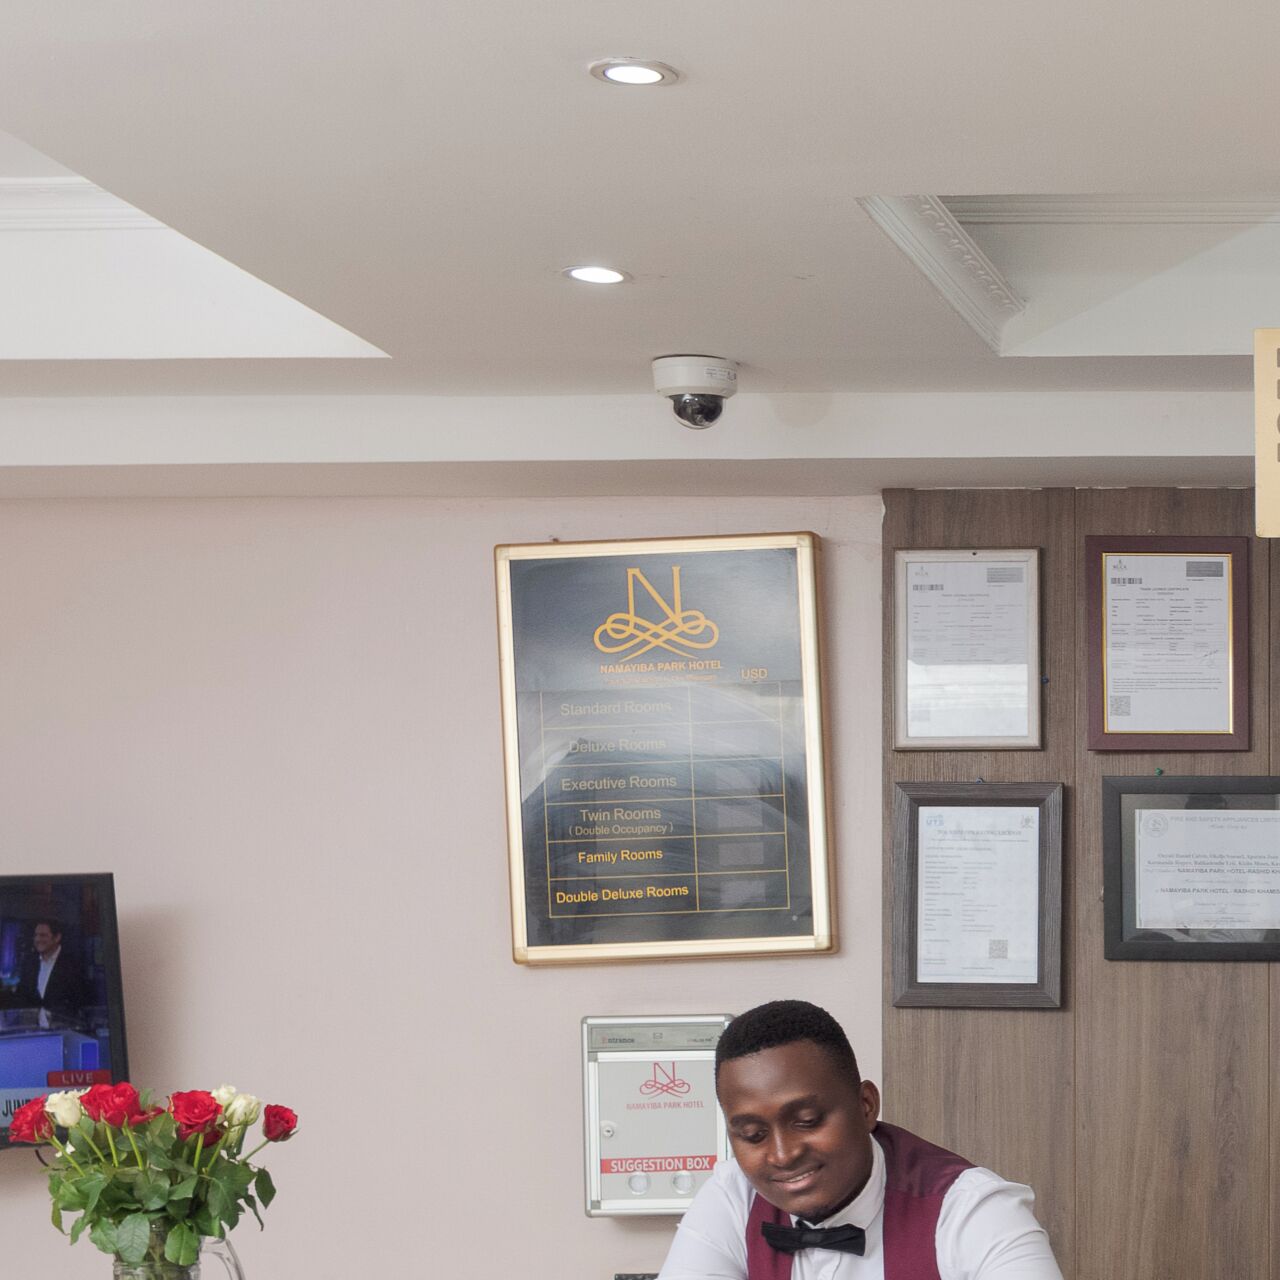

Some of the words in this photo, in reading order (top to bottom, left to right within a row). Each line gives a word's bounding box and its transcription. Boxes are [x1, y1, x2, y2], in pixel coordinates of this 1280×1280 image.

[600, 663, 655, 674] NAMAYIBA
[657, 661, 686, 672] PARK
[689, 660, 722, 671] HOTEL
[741, 668, 768, 679] USD
[560, 703, 620, 715] Standard
[625, 702, 672, 713] Rooms
[569, 740, 616, 753] Deluxe
[619, 738, 666, 750] Rooms
[561, 777, 626, 791] Executive
[630, 776, 677, 789] Rooms
[580, 809, 610, 822] Twin
[614, 808, 661, 820] Rooms
[578, 851, 617, 864] Family
[621, 850, 663, 861] Rooms
[556, 891, 598, 904] Double
[602, 888, 643, 901] Deluxe
[646, 885, 689, 898] Rooms
[62, 1073, 93, 1083] LIVE
[627, 1102, 661, 1110] NAMAYIBA
[611, 1159, 684, 1172] SUGGESTION
[686, 1157, 710, 1170] BOX
